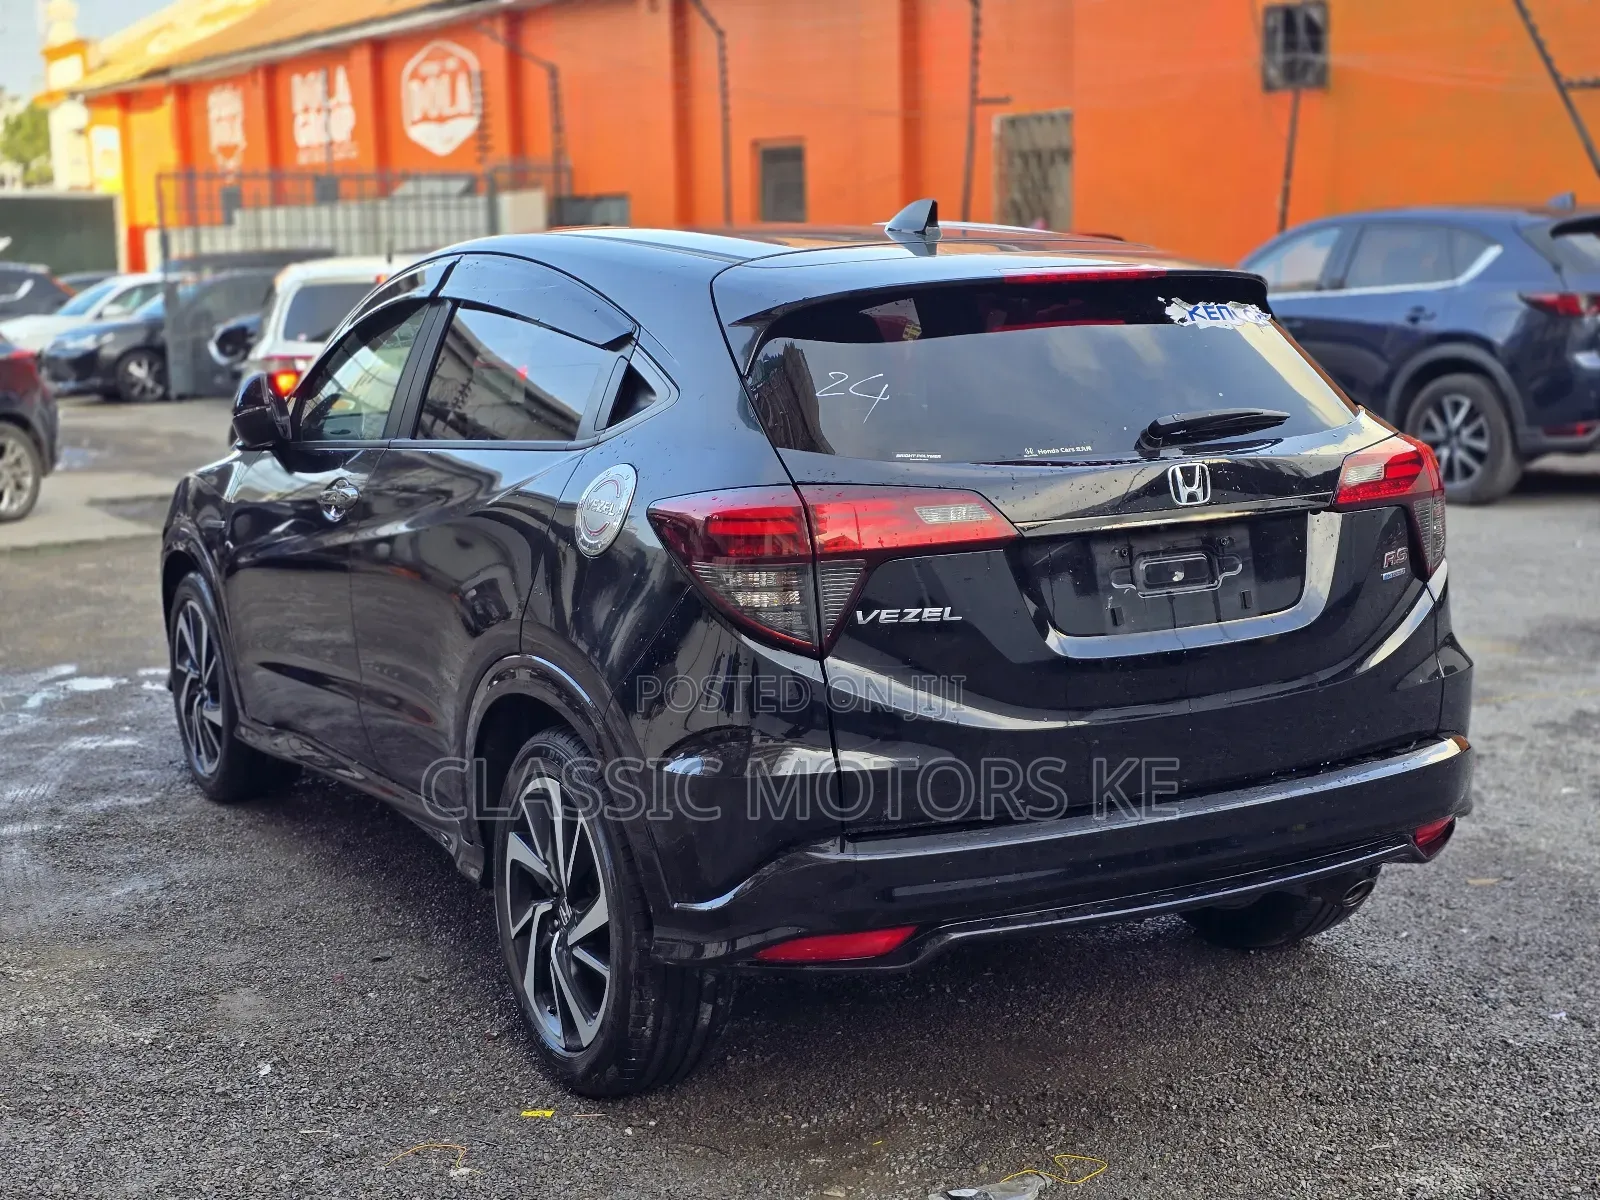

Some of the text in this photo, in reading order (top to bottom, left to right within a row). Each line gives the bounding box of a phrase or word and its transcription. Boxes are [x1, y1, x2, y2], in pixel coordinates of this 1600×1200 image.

[816, 371, 889, 424] 24
[1037, 447, 1060, 455] Honda
[1060, 446, 1076, 454] Cars
[586, 497, 616, 517] VEZEL
[1383, 546, 1409, 568] RS
[855, 606, 963, 625] VEZEL
